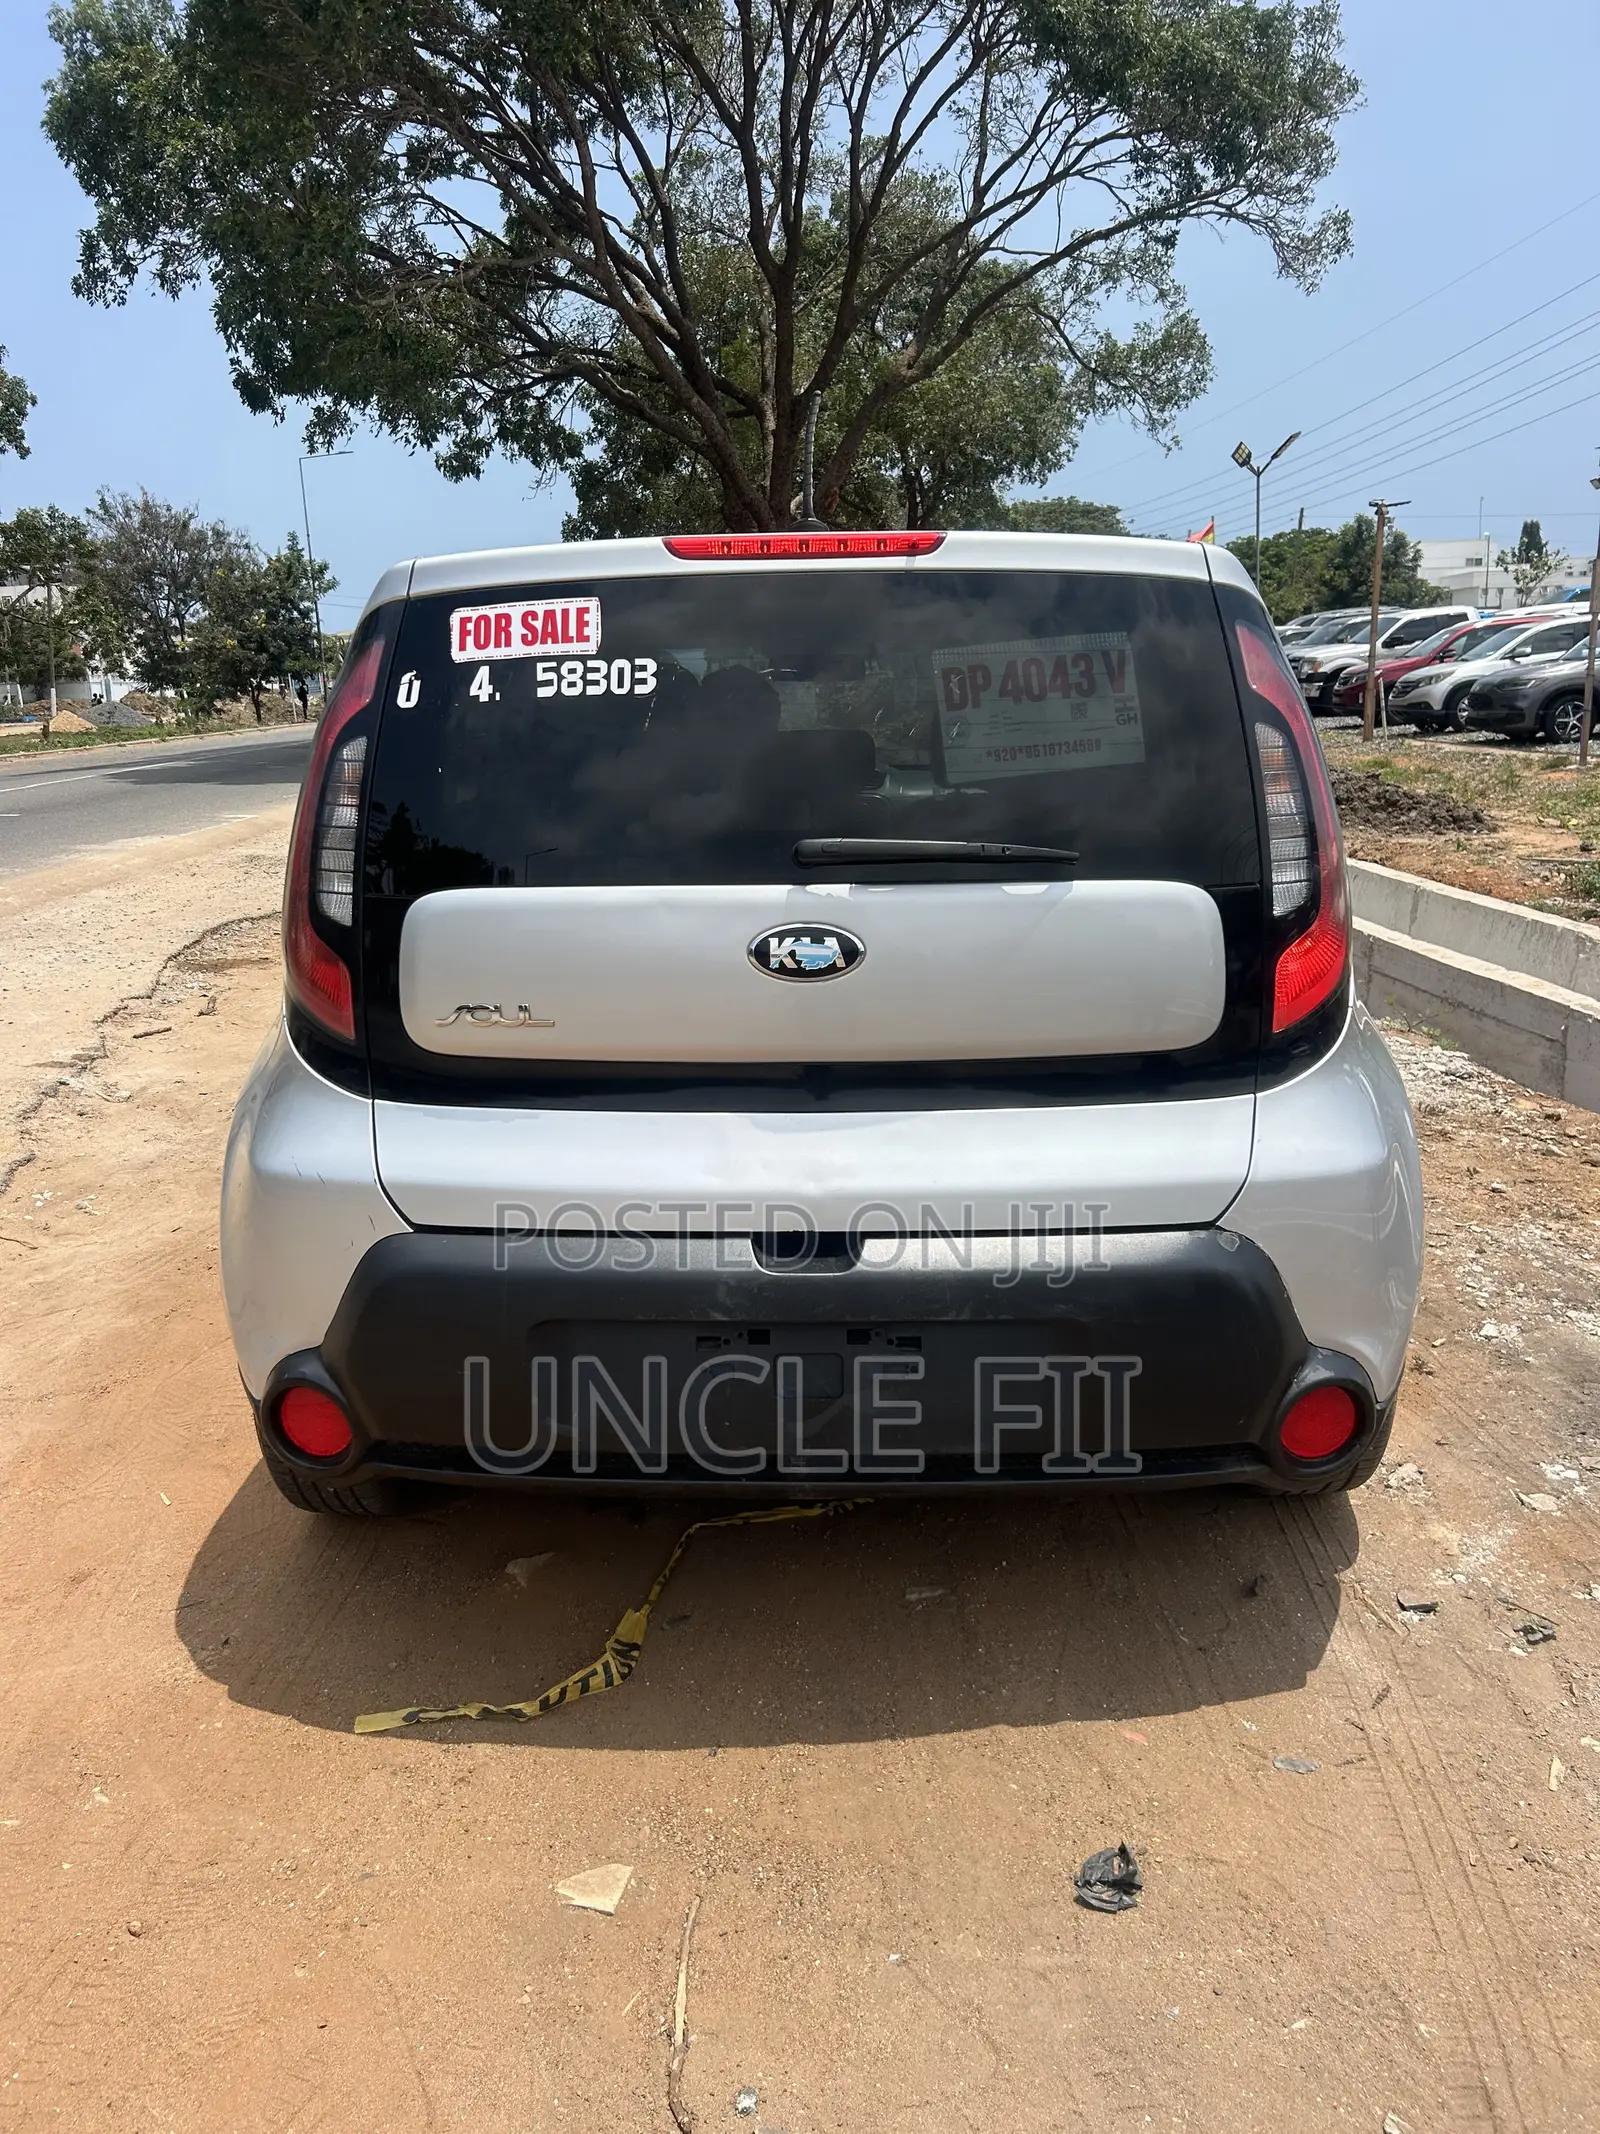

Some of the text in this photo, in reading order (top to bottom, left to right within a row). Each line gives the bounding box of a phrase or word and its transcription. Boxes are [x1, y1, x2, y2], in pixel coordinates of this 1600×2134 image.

[458, 606, 591, 652] FOR SALE
[536, 658, 657, 698] 58303
[941, 651, 1126, 712] DP 4043 V
[1115, 711, 1138, 727] GH
[434, 1003, 555, 1028] SOUL
